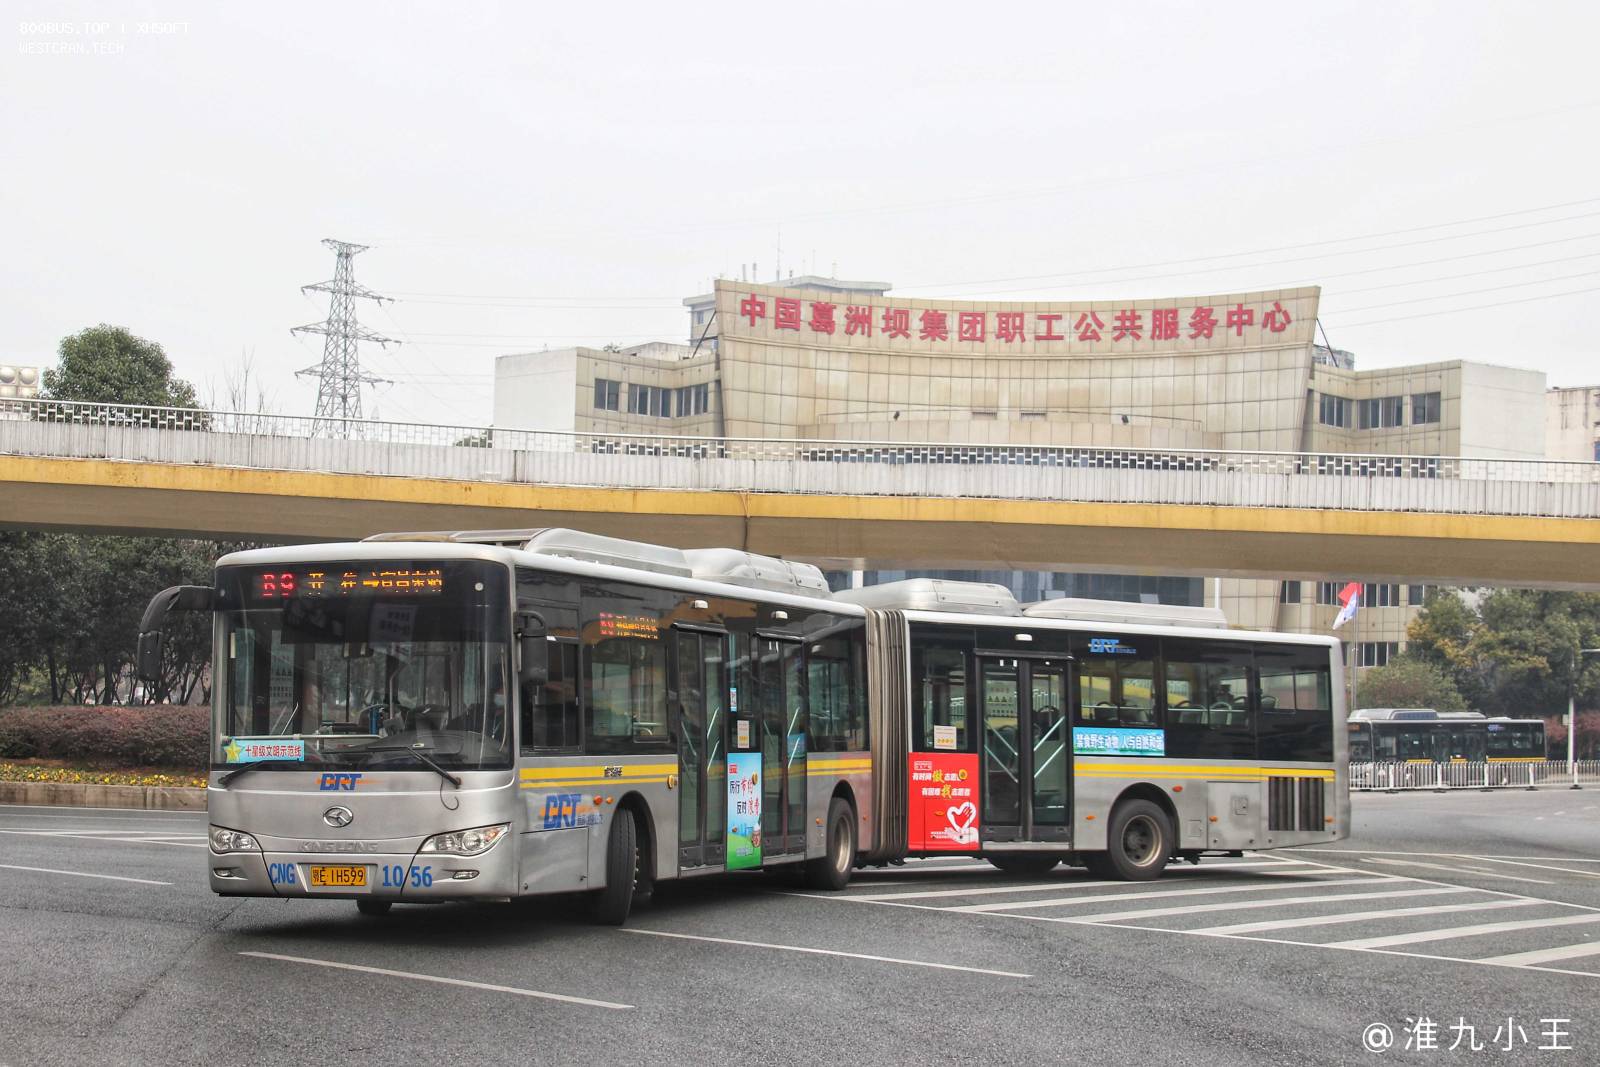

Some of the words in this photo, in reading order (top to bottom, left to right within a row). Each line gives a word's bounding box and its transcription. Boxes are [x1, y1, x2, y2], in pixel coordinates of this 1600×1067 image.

[740, 293, 1292, 343] 中国葛洲坝集团职工公共服务中心
[1090, 638, 1119, 653] BRT
[245, 744, 302, 758] 十星级文明示范线
[320, 773, 361, 791] BRT
[544, 793, 582, 829] BRT
[269, 863, 296, 884] CNG
